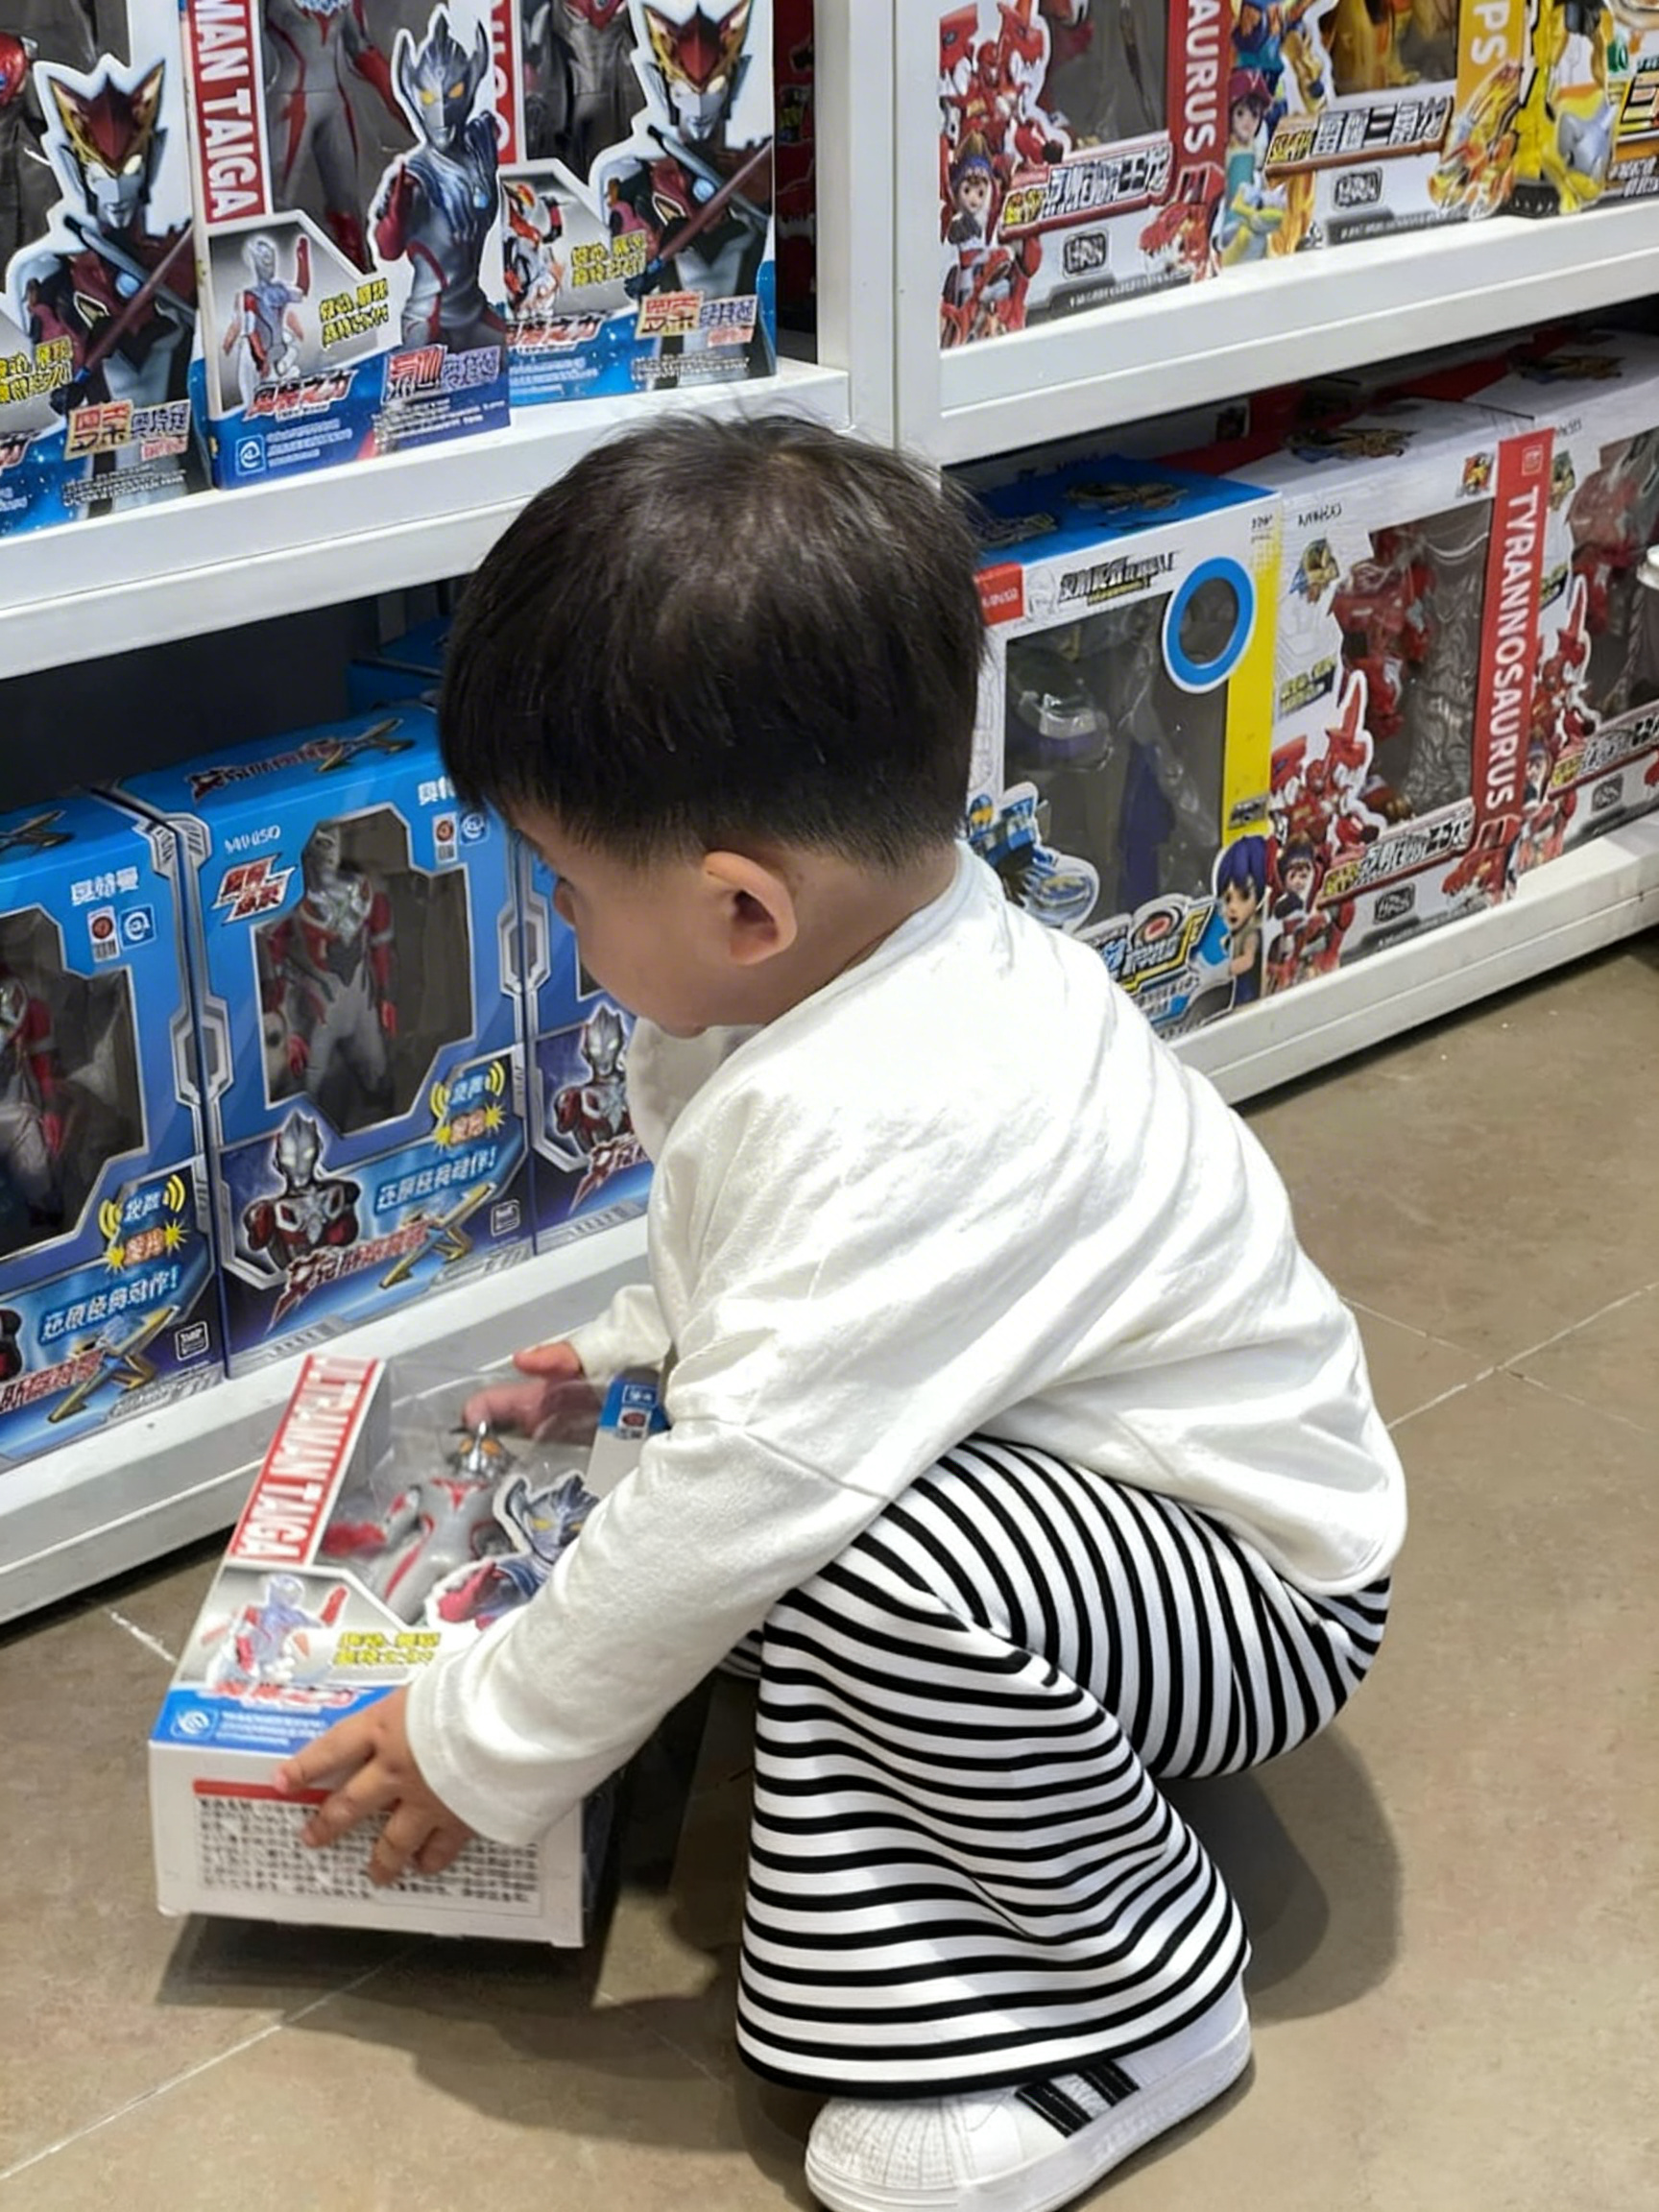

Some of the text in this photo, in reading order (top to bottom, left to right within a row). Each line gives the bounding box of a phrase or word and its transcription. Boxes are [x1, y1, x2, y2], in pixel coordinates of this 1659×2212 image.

[1183, 0, 1221, 154] AURUS
[1471, 0, 1510, 64] PS
[203, 88, 258, 218] TAIGA
[1486, 484, 1539, 810] TYRANNOSAURUS
